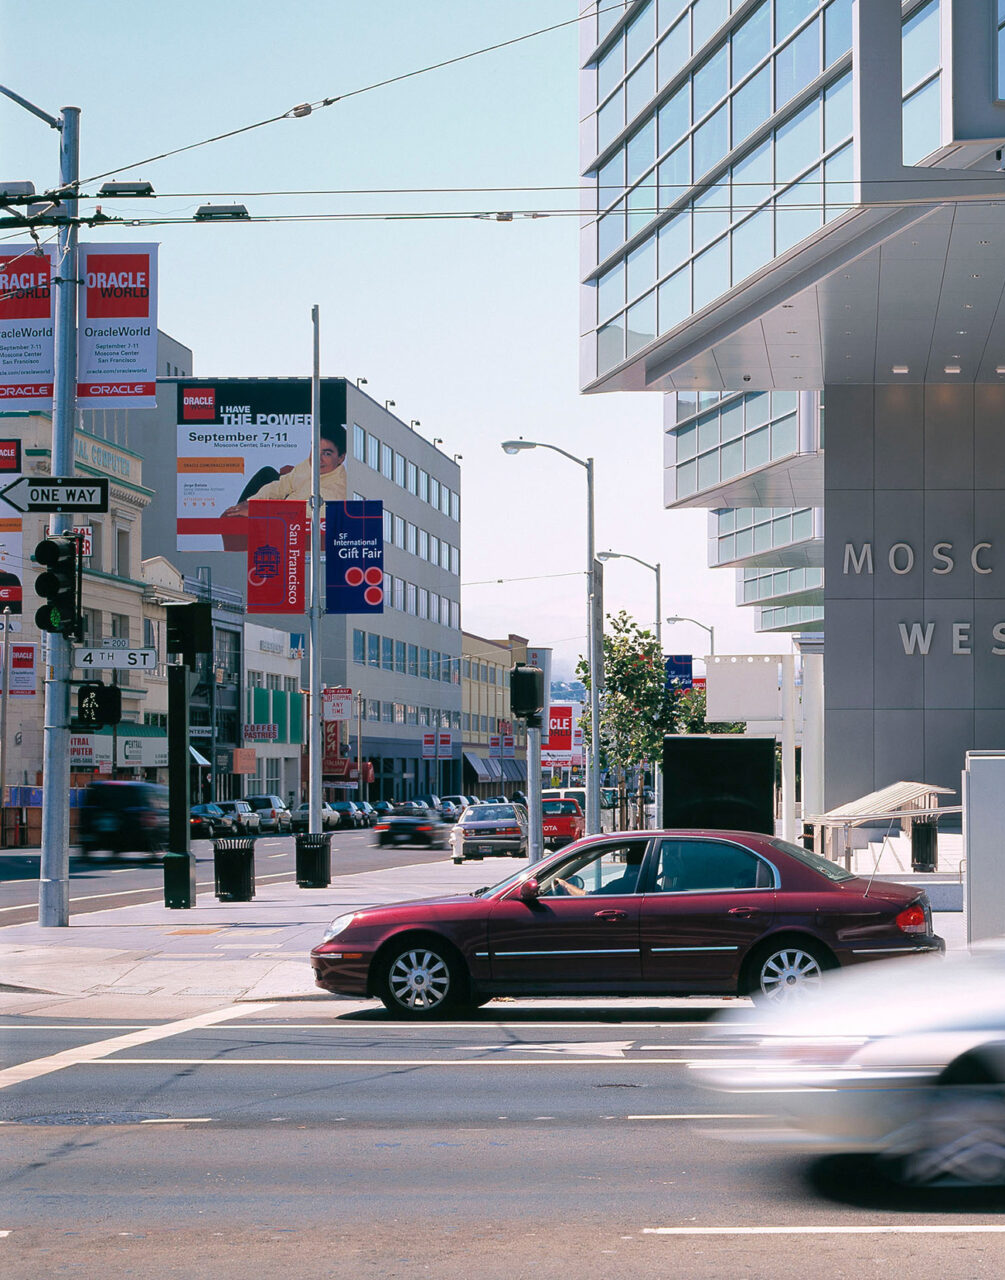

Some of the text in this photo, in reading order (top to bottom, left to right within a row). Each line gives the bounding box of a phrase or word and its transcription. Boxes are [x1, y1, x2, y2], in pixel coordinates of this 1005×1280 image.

[87, 272, 146, 288] ORACLE
[101, 287, 149, 298] WORLD
[85, 327, 151, 337] OracleWorld
[90, 385, 144, 395] ORACLE
[184, 396, 214, 406] ORACLE
[220, 414, 312, 425] THE POWER
[188, 432, 288, 443] September 7-11
[30, 489, 97, 502] ONE WAY
[338, 532, 349, 540] SF
[333, 539, 378, 547] International
[338, 548, 383, 559] Gift Fair
[288, 524, 301, 605] San Francisco
[111, 639, 127, 648] 200
[127, 652, 150, 666] ST
[244, 724, 278, 732] COFFEE
[244, 731, 277, 739] PASTRIES
